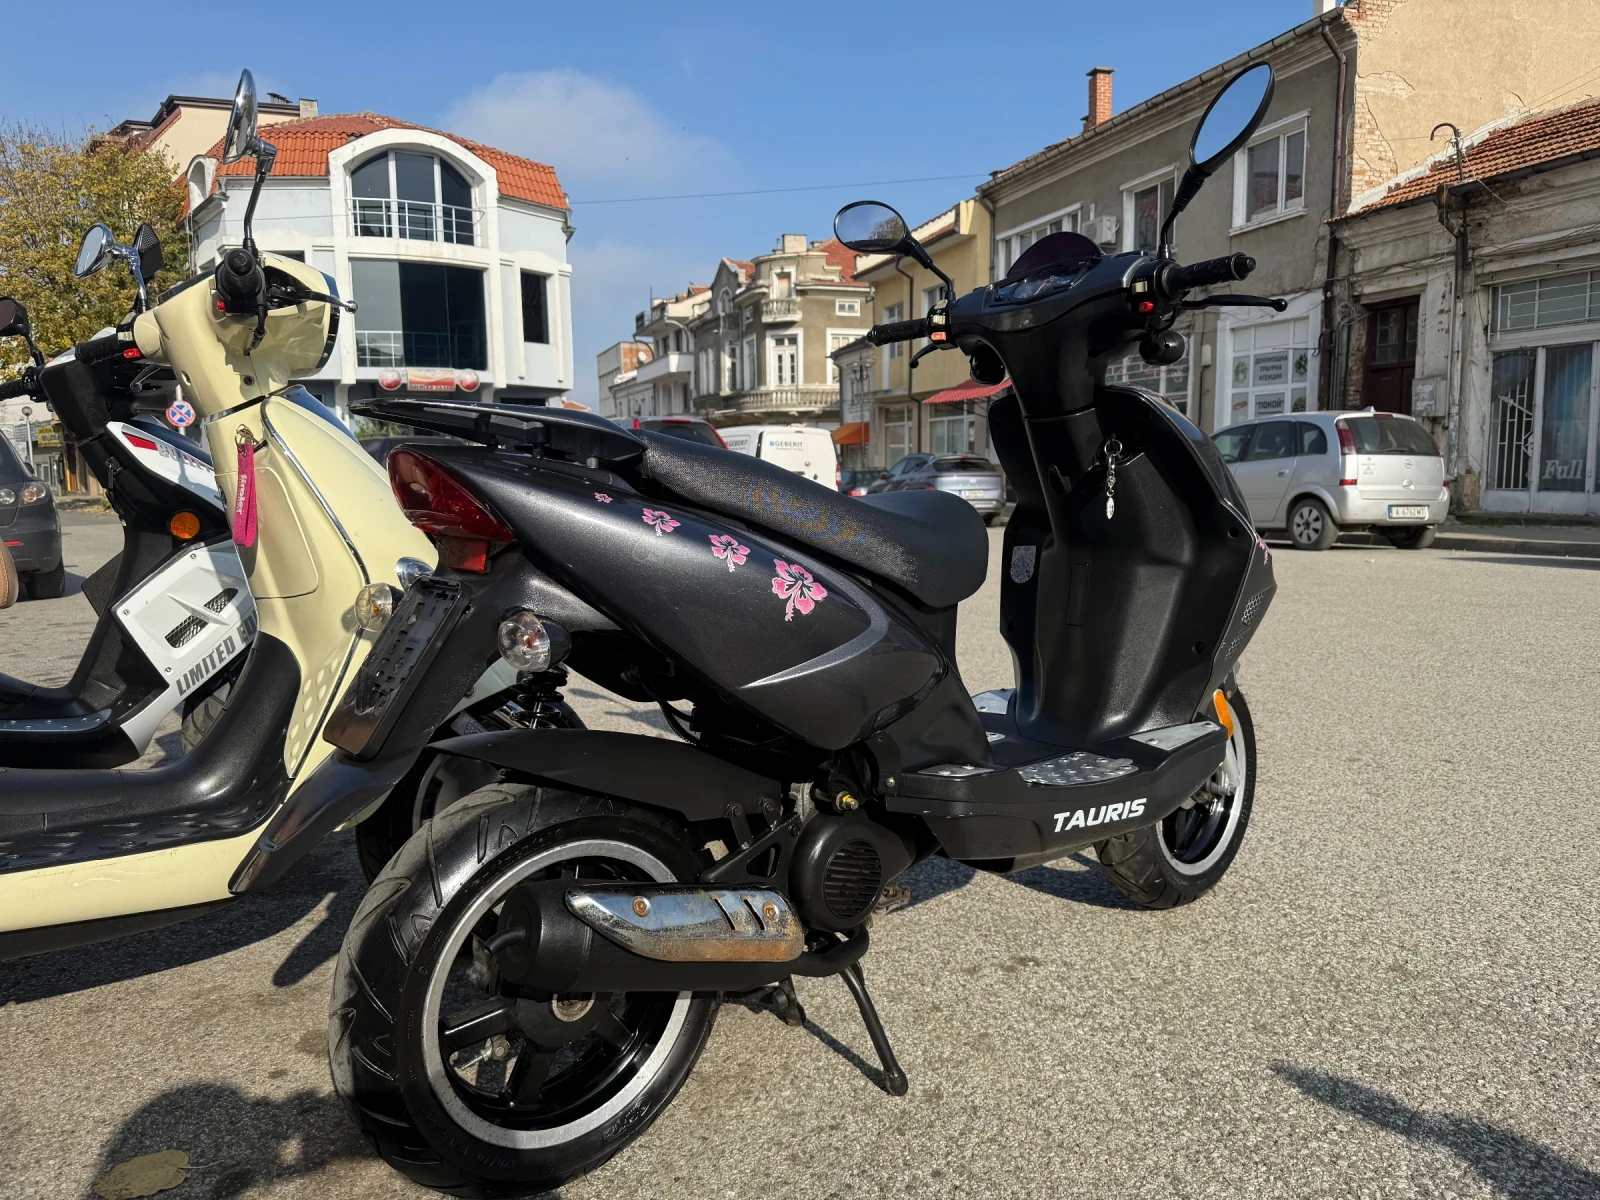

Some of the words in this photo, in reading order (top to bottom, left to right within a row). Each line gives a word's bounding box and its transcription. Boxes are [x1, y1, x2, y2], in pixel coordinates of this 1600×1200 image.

[1255, 354, 1288, 364] ДЕНОНОЩНА
[1259, 373, 1283, 381] АГЕНЦИЯ
[775, 440, 803, 448] GEBERIT
[1542, 459, 1584, 480] Full
[176, 635, 237, 697] LIMITED
[1053, 798, 1147, 832] TAURIS
